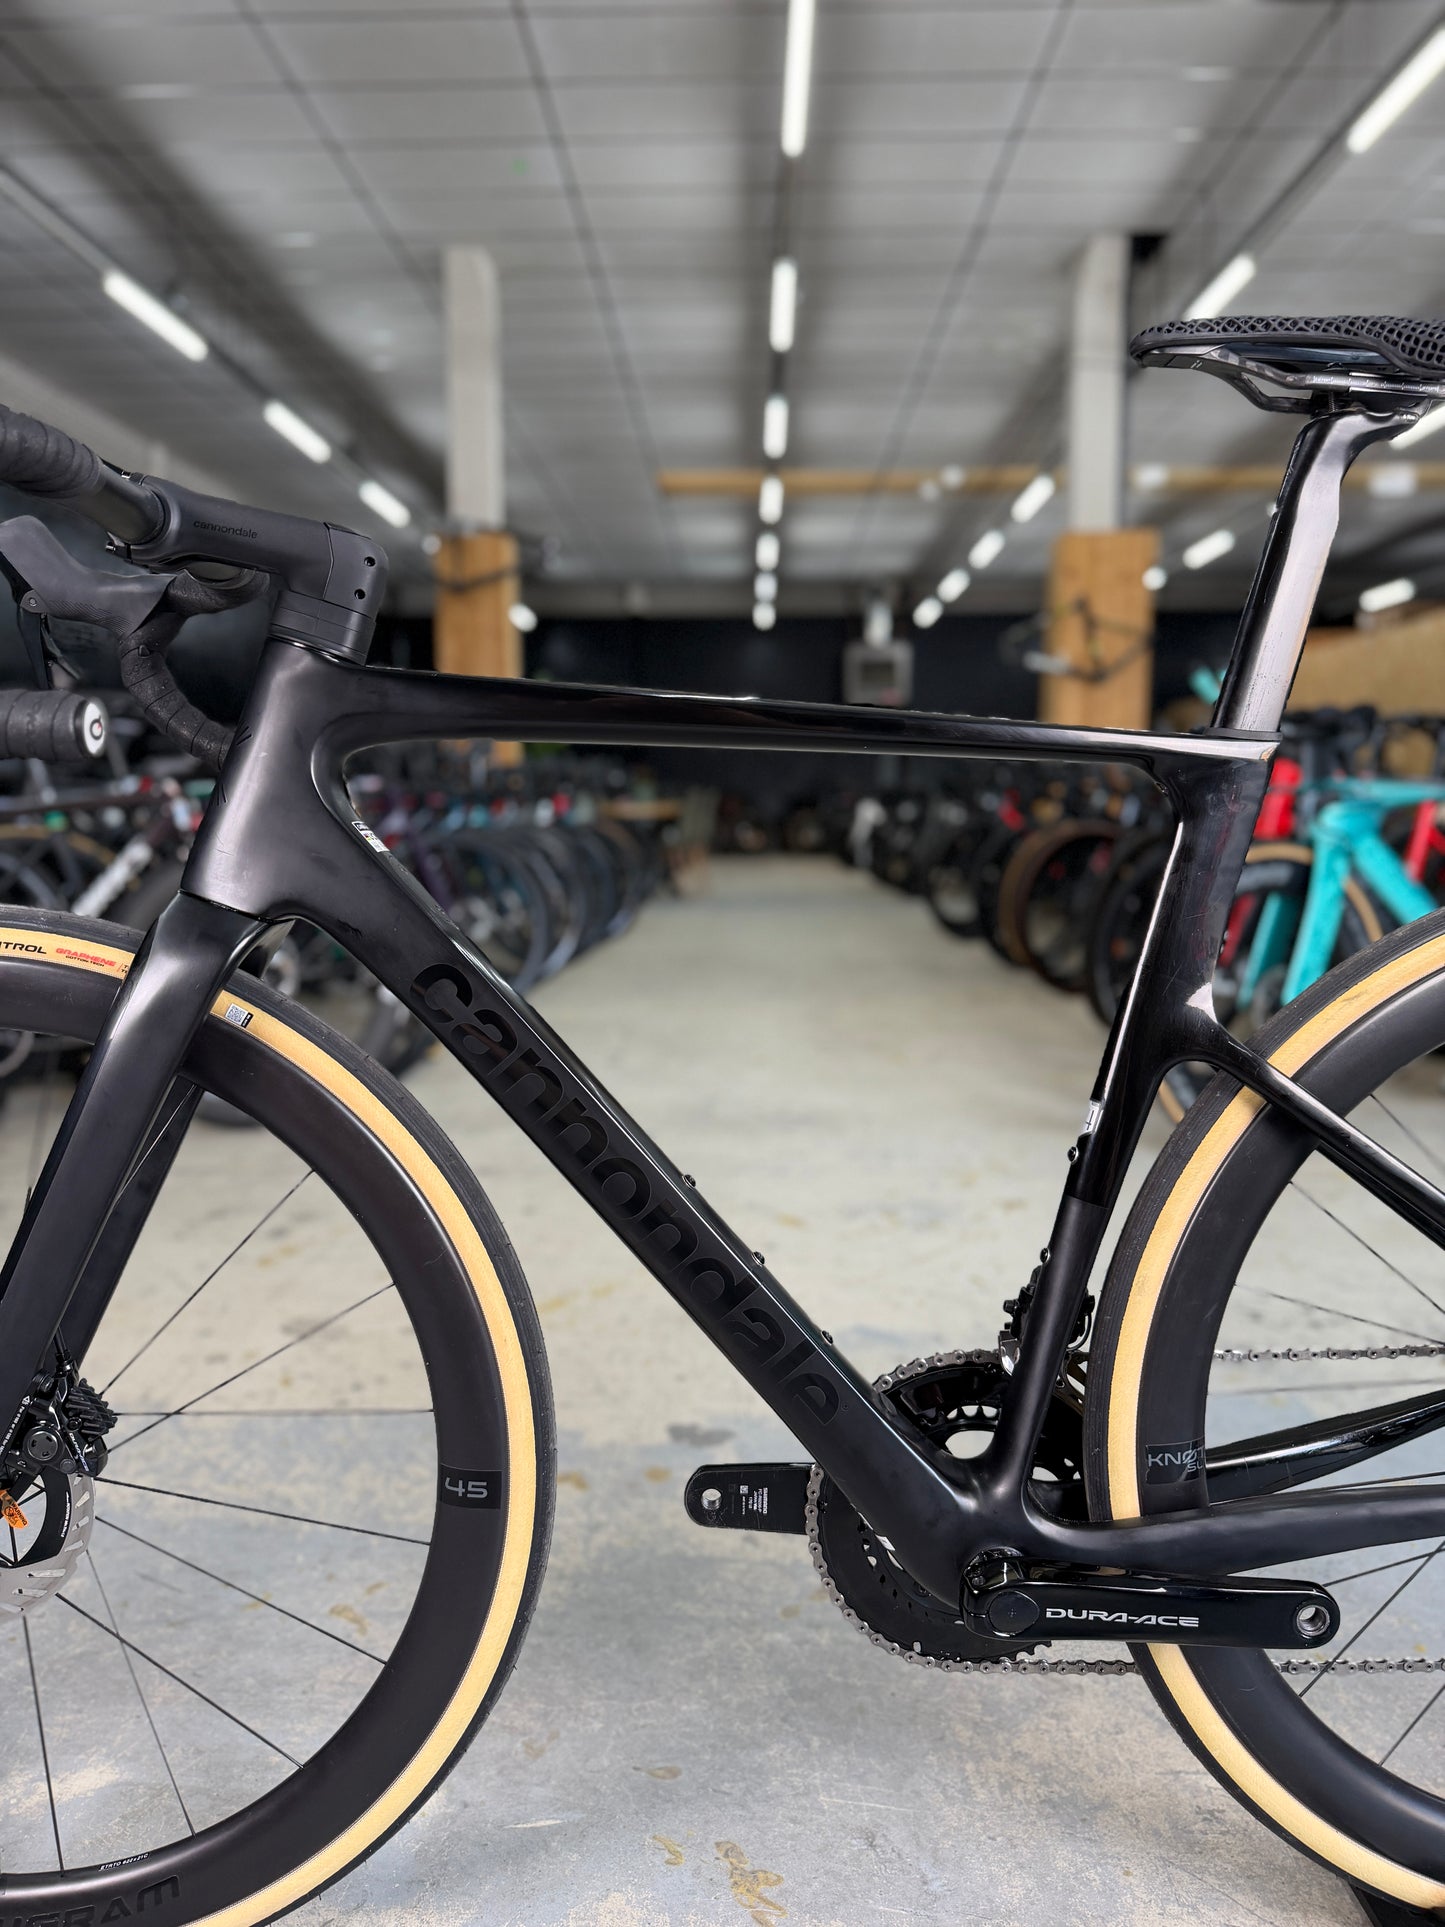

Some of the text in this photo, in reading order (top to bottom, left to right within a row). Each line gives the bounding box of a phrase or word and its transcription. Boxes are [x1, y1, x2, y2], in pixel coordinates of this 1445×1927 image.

[193, 520, 258, 539] cannondale
[0, 941, 47, 954] TROL
[56, 947, 117, 967] GRAPHENE
[409, 963, 841, 1426] cannondale
[445, 1477, 488, 1499] 45
[1045, 1608, 1200, 1628] DURA-ACE
